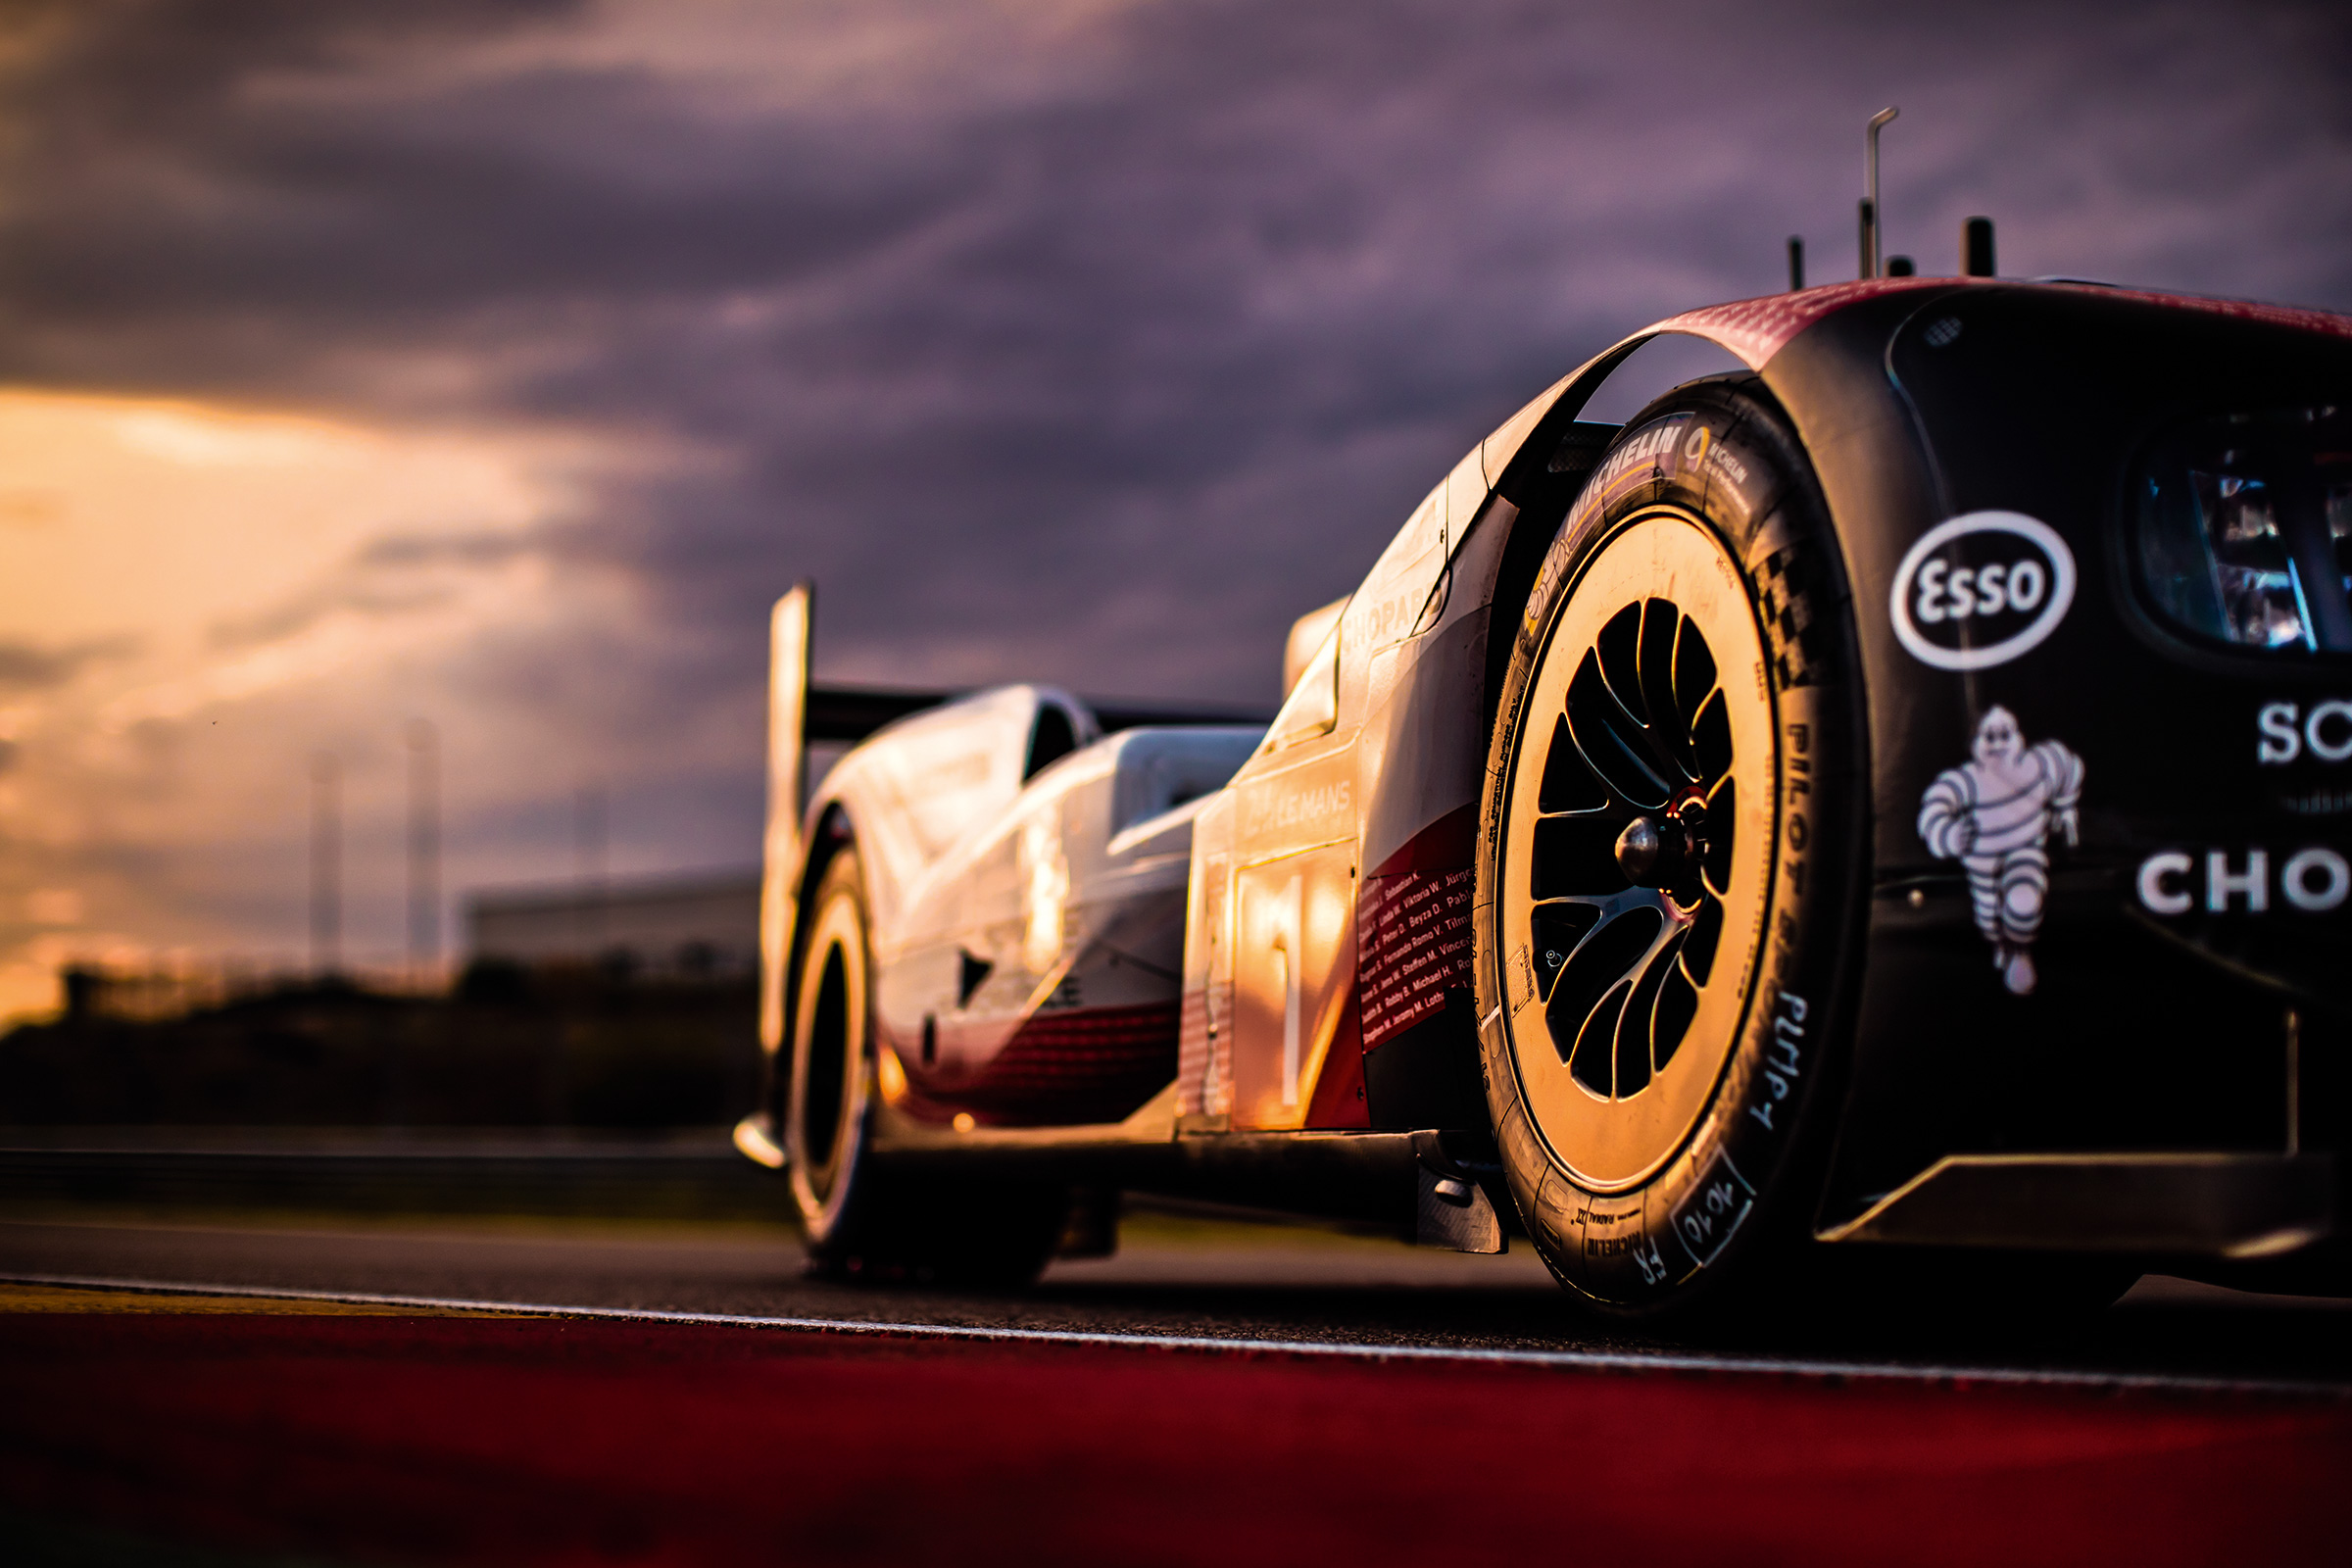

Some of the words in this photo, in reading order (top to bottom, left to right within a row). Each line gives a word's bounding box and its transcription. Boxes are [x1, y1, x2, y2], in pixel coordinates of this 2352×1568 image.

[1566, 425, 1683, 534] MICHELIN
[1708, 442, 1748, 484] MICHELIN
[1343, 582, 1434, 656] CHOPAR
[1785, 722, 1811, 897] PILOT
[1403, 887, 1431, 908] Viktoria
[1429, 880, 1443, 894] W.
[2136, 848, 2352, 914] CHO
[1409, 909, 1432, 928] Beyza
[1411, 931, 1434, 948] Romo
[1433, 924, 1445, 936] V.
[1412, 968, 1442, 992] Michael
[1442, 964, 1453, 977] H.
